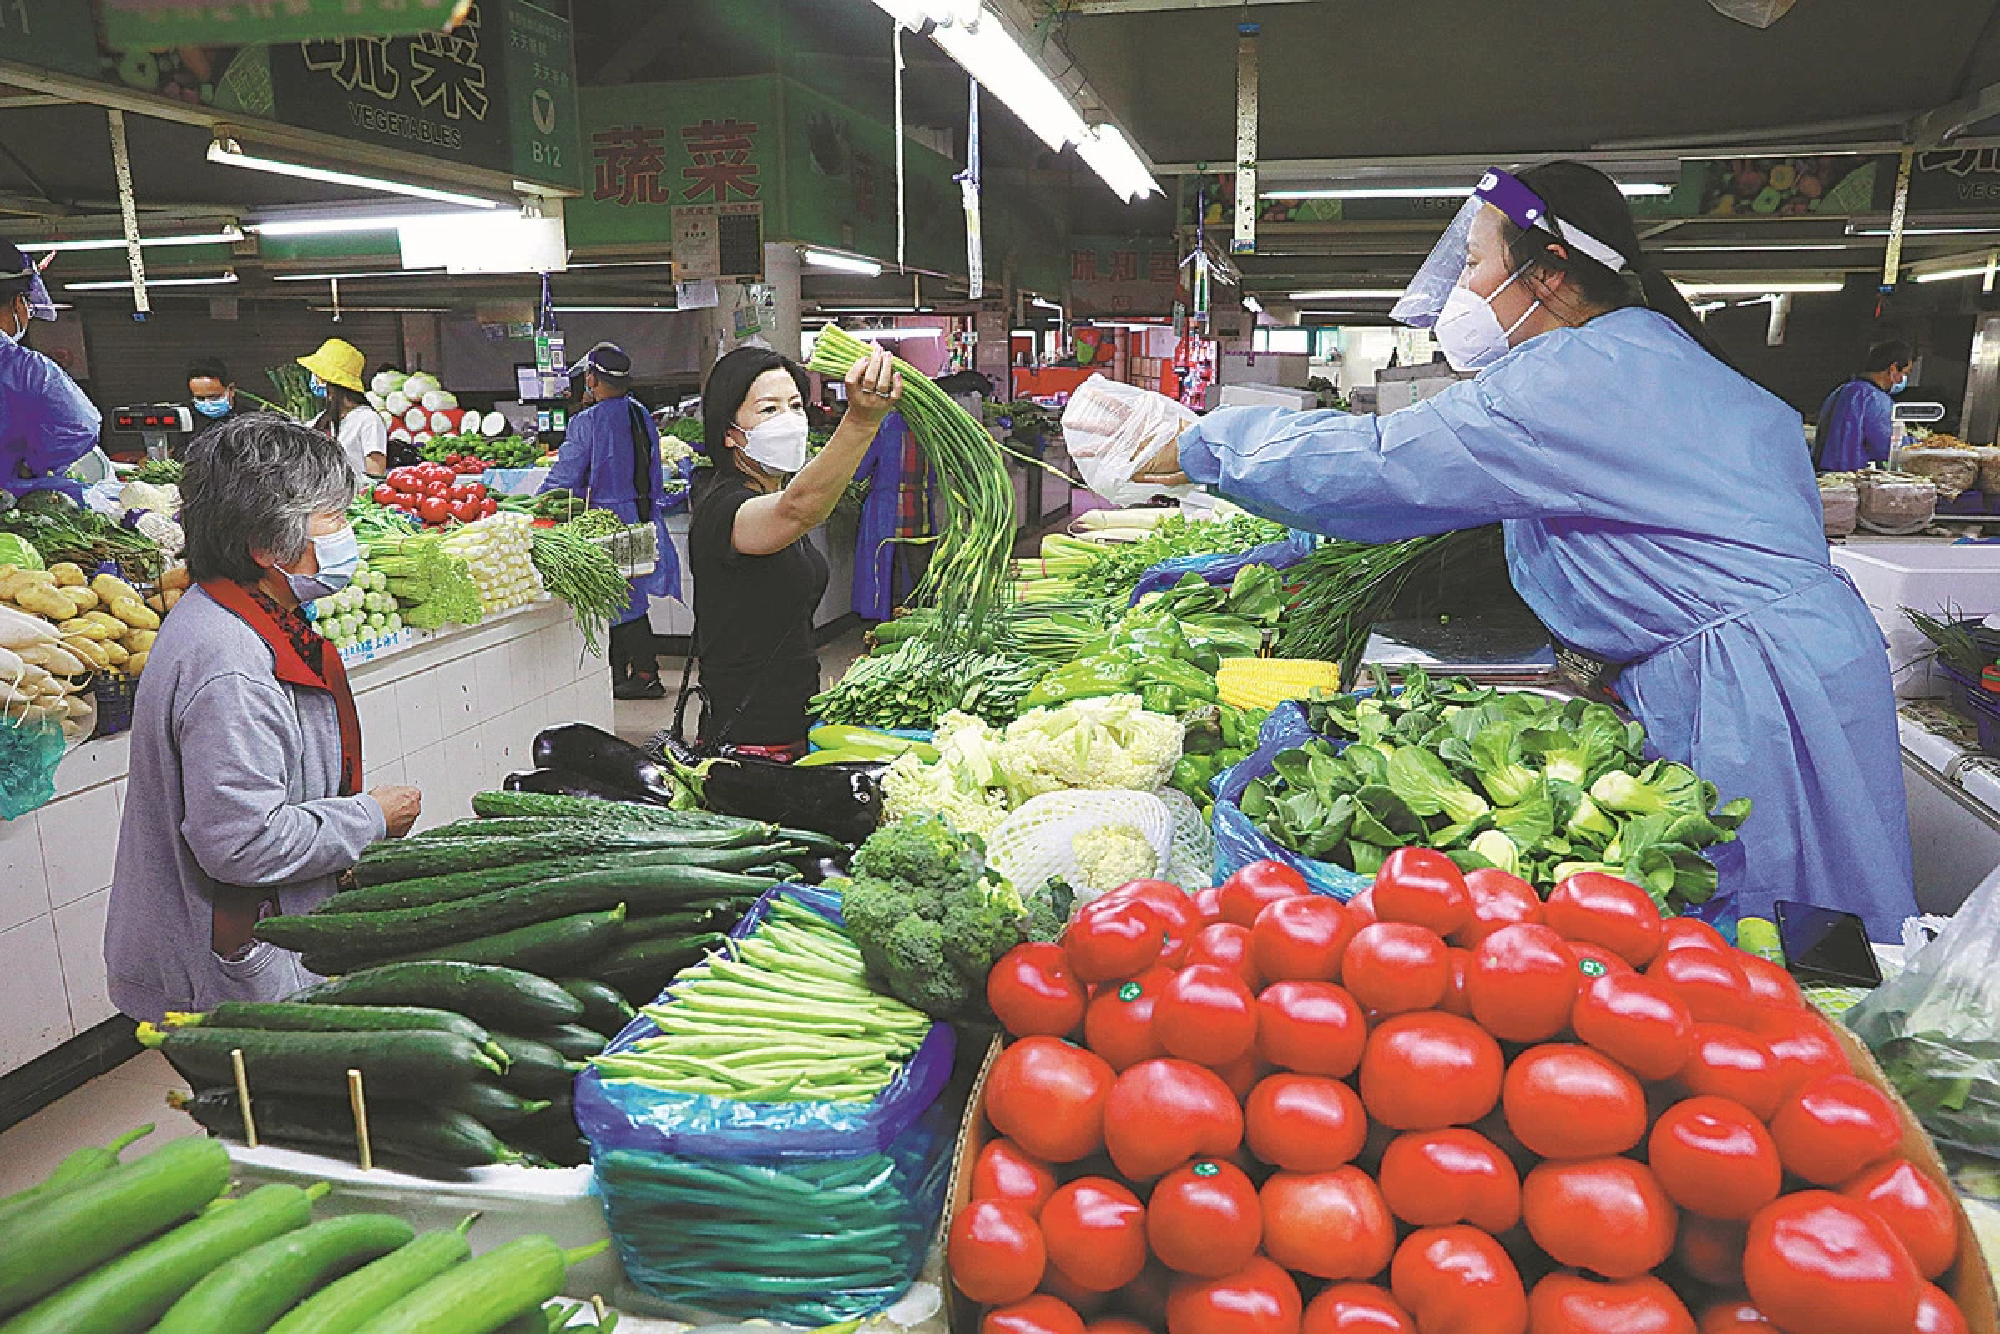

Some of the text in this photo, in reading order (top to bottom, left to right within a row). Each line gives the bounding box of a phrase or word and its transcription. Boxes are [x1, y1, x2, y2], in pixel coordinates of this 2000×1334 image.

[348, 101, 462, 150] VEGETABLES
[532, 140, 562, 168] B12
[592, 117, 762, 206] 蔬菜
